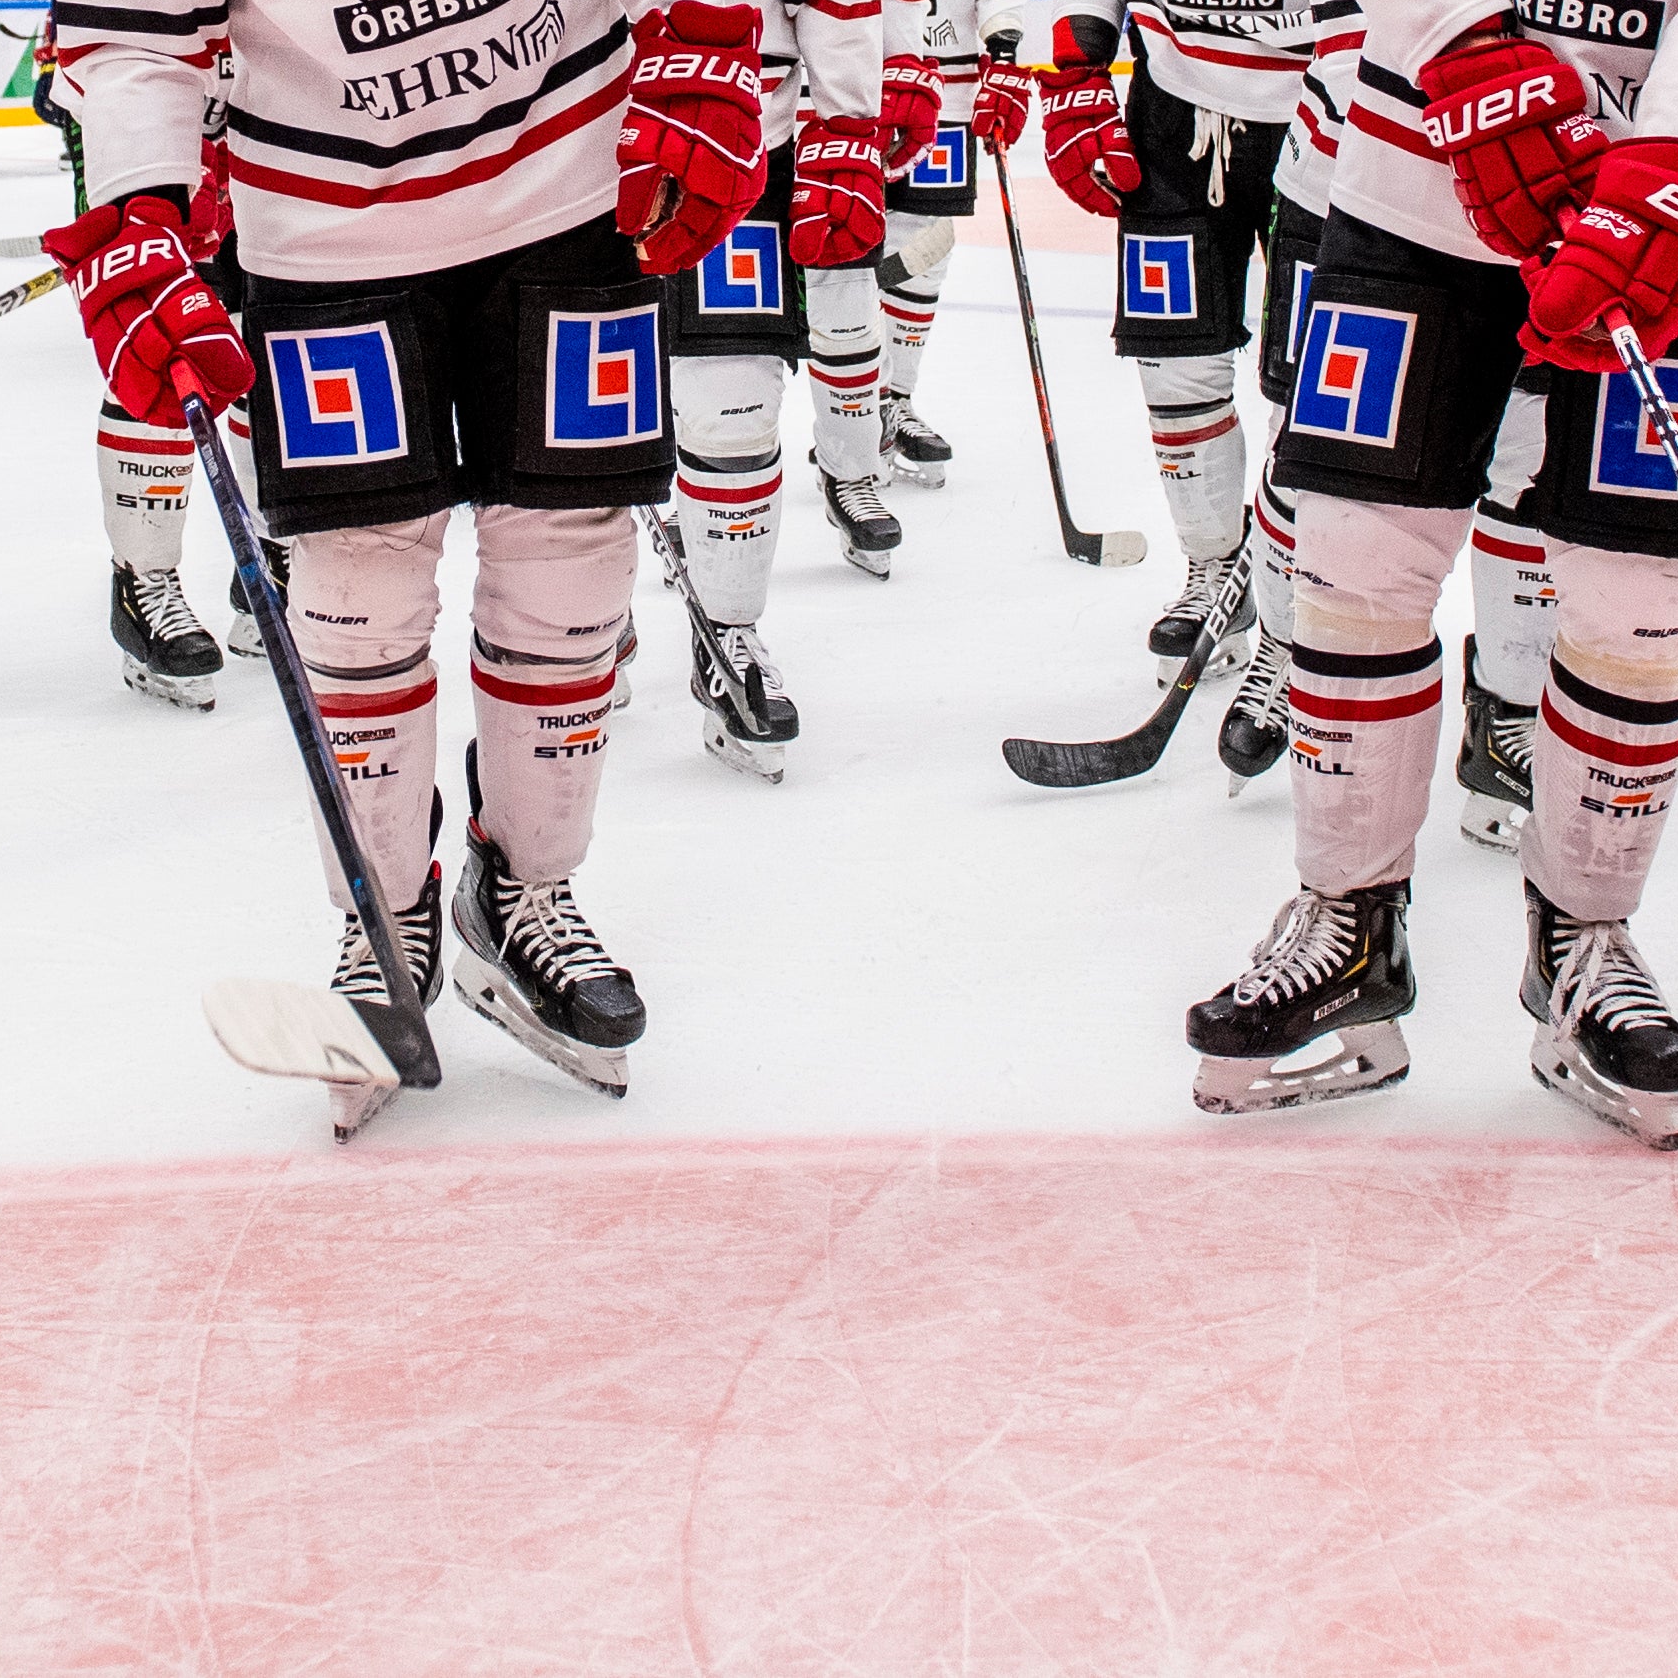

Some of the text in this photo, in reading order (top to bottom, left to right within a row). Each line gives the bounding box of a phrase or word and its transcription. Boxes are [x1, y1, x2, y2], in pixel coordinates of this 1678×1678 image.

[1580, 203, 1646, 236] NEXUS
[706, 527, 771, 542] STILL
[533, 732, 611, 759] STILL
[1579, 795, 1670, 819] STILL
